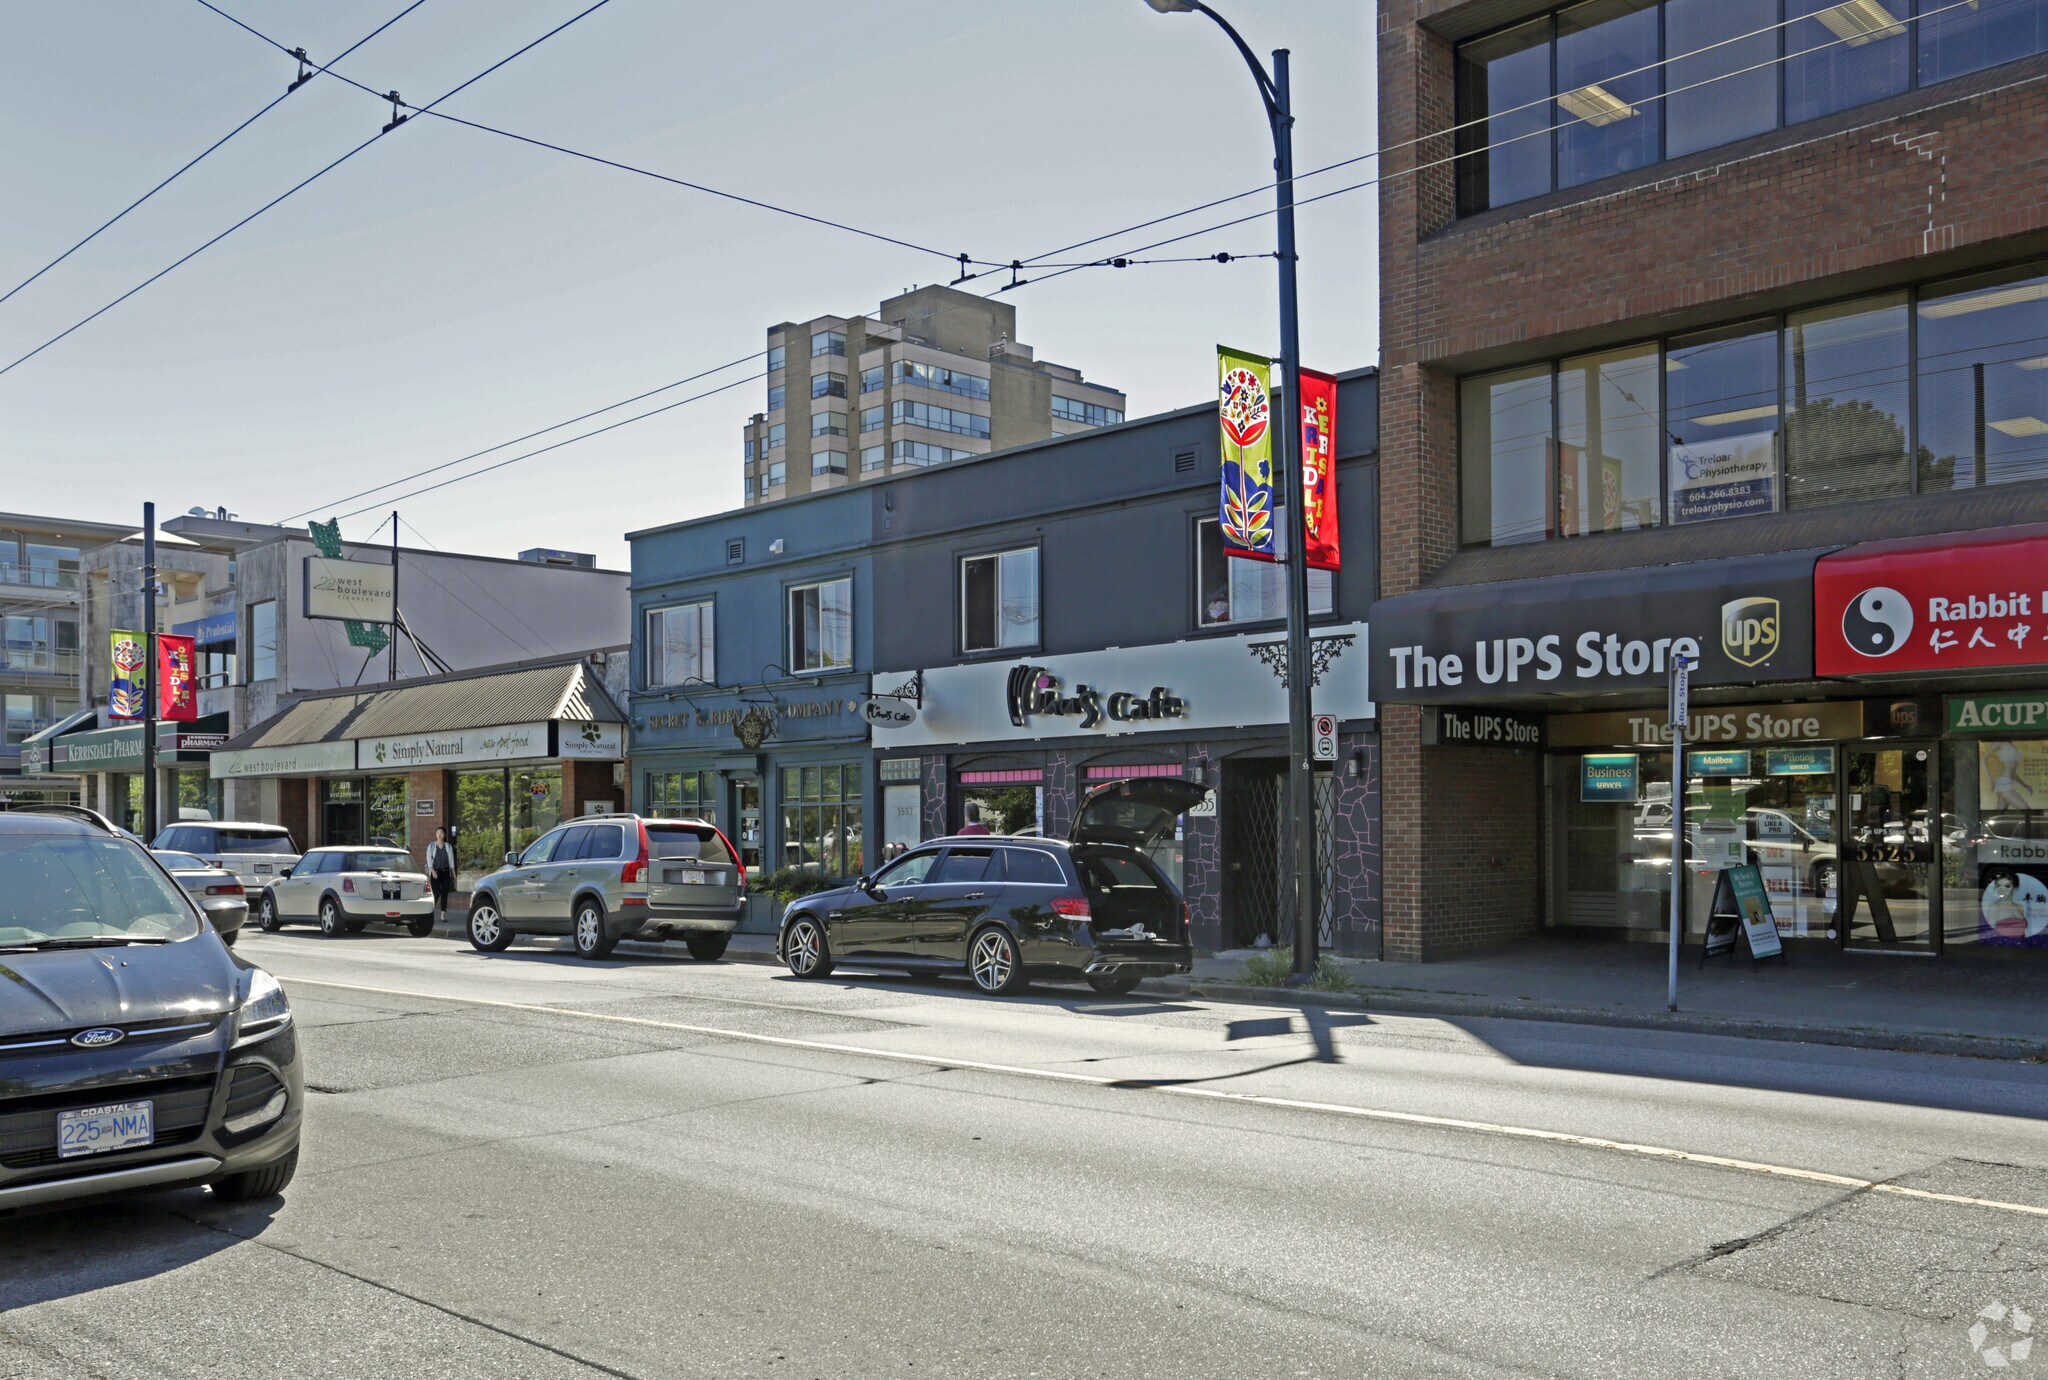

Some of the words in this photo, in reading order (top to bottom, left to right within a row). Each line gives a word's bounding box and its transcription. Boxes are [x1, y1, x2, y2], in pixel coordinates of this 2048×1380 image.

[1699, 454, 1731, 464] Treloar
[1700, 462, 1767, 478] Physiotherapy
[1689, 486, 1751, 502] 604.266.8383
[1682, 498, 1764, 516] treloarphysio.com
[337, 578, 362, 587] west
[337, 585, 391, 598] boulevard
[1929, 592, 2031, 622] Rabbit
[206, 621, 235, 637] Prudential
[1727, 618, 1776, 656] ups
[1929, 624, 2048, 654] 仁人中
[1390, 646, 1463, 689] The
[1476, 635, 1562, 684] UPS
[1576, 631, 1700, 678] Store
[649, 713, 689, 729] SECRET
[697, 708, 742, 727] RDEN
[781, 700, 843, 719] OMPANY
[1957, 701, 2048, 727] ACUP
[1444, 713, 1471, 740] The
[1474, 715, 1501, 742] UPS
[1505, 717, 1539, 744] Store
[1628, 717, 1673, 743] The
[1685, 714, 1737, 742] UPS
[1746, 712, 1819, 738] Store
[68, 742, 113, 762] KERRISDALE
[392, 741, 424, 764] Simply
[425, 737, 463, 756] Natural
[564, 741, 588, 750] Simply
[589, 742, 616, 750] Natural
[244, 762, 260, 772] west
[261, 759, 297, 772] boulevard
[1703, 756, 1733, 765] Mailbox
[1784, 753, 1816, 764] Printing
[1587, 766, 1632, 778] Business
[1596, 781, 1622, 790] SERVICES
[1193, 798, 1214, 812] 55
[1857, 843, 1916, 861] 5525
[2000, 845, 2048, 858] Rabb
[85, 1030, 113, 1044] Ford
[81, 1104, 131, 1117] COASTAL
[63, 1120, 100, 1145] 225
[113, 1114, 148, 1138] NMA
[63, 1149, 94, 1158] BURNABY
[113, 1141, 150, 1150] VANCOUVER
